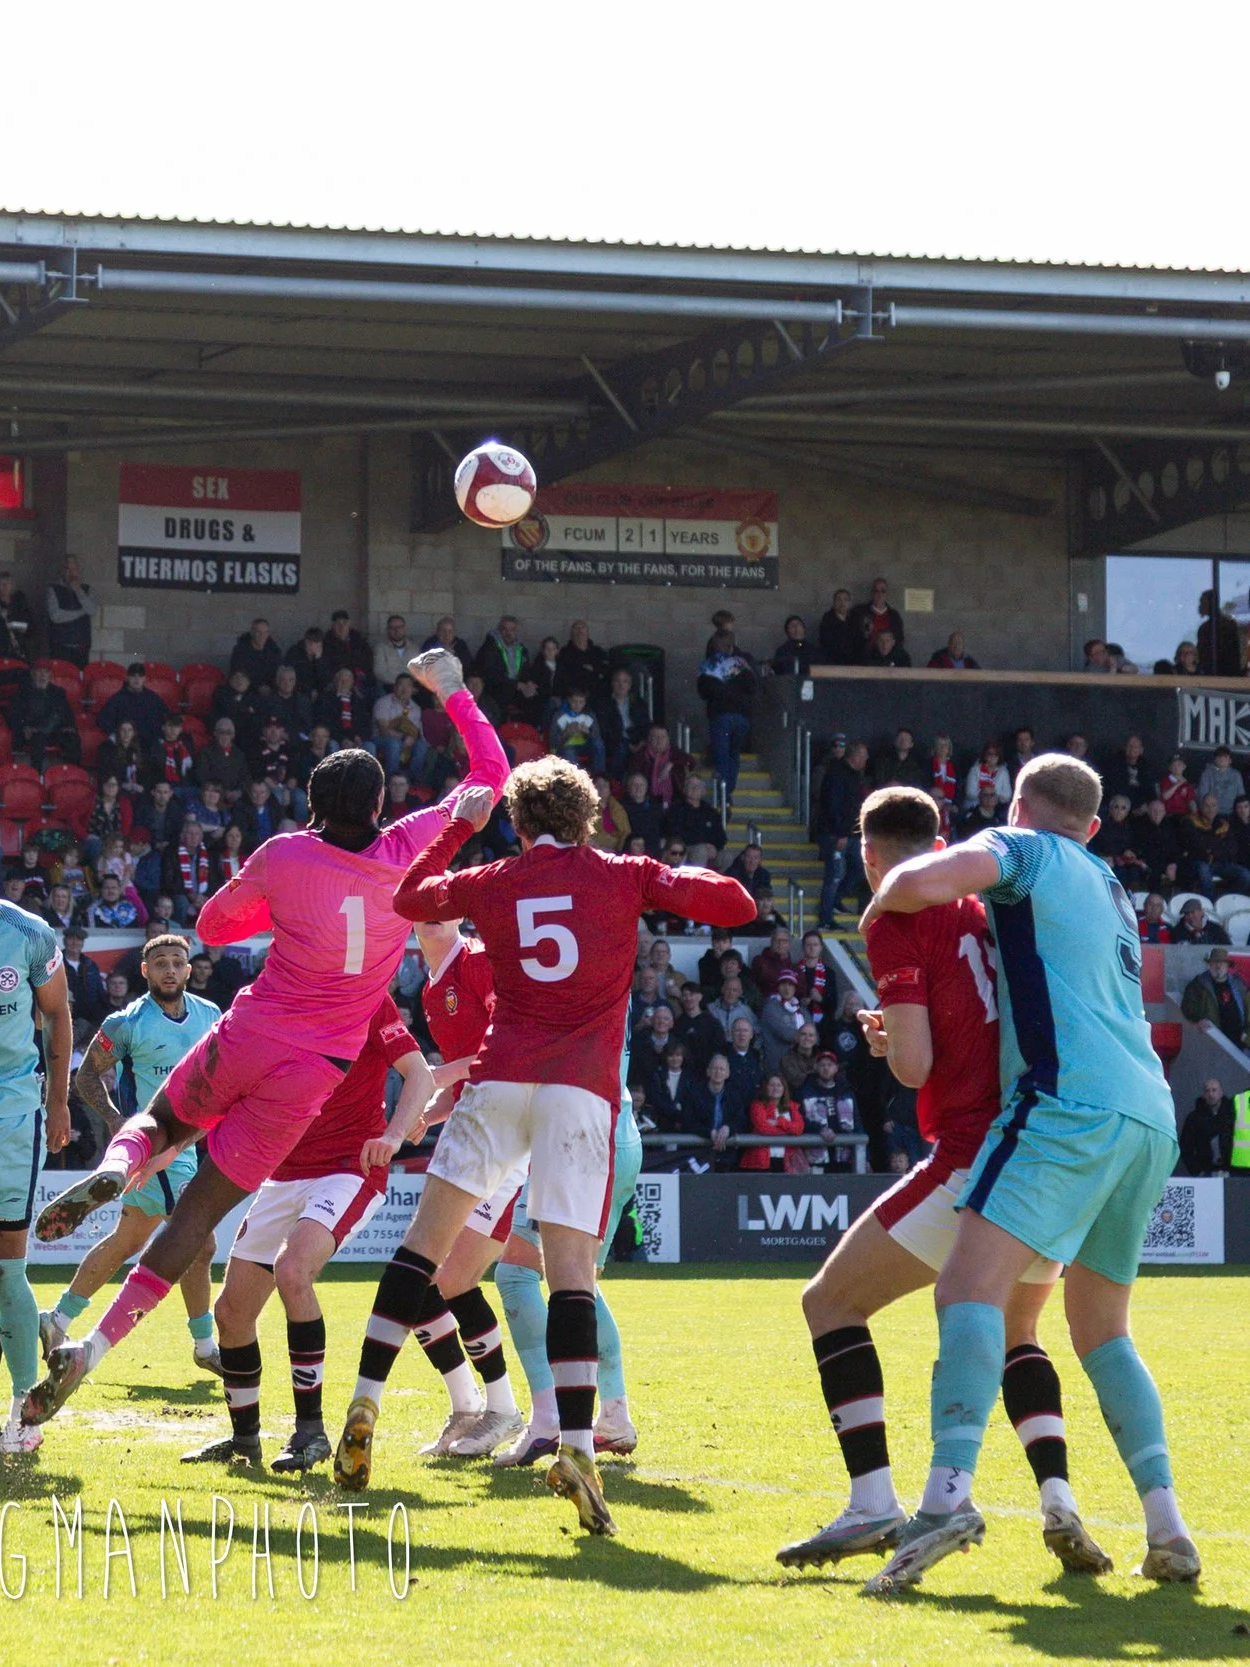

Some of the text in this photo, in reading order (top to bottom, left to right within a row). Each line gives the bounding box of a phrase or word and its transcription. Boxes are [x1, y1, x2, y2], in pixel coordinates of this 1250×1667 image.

[192, 476, 230, 500] SEX
[164, 517, 255, 542] DRUGS &
[564, 527, 719, 545] FCUM 2 1 YEARS
[121, 555, 298, 586] THERMOS FLASKS
[515, 559, 766, 579] OF THE FANS, BY THE FANS, FOR THE FANS
[338, 896, 366, 975] 1
[516, 895, 579, 983] 5
[738, 1195, 848, 1230] LWM
[761, 1237, 826, 1246] MORTGAGES
